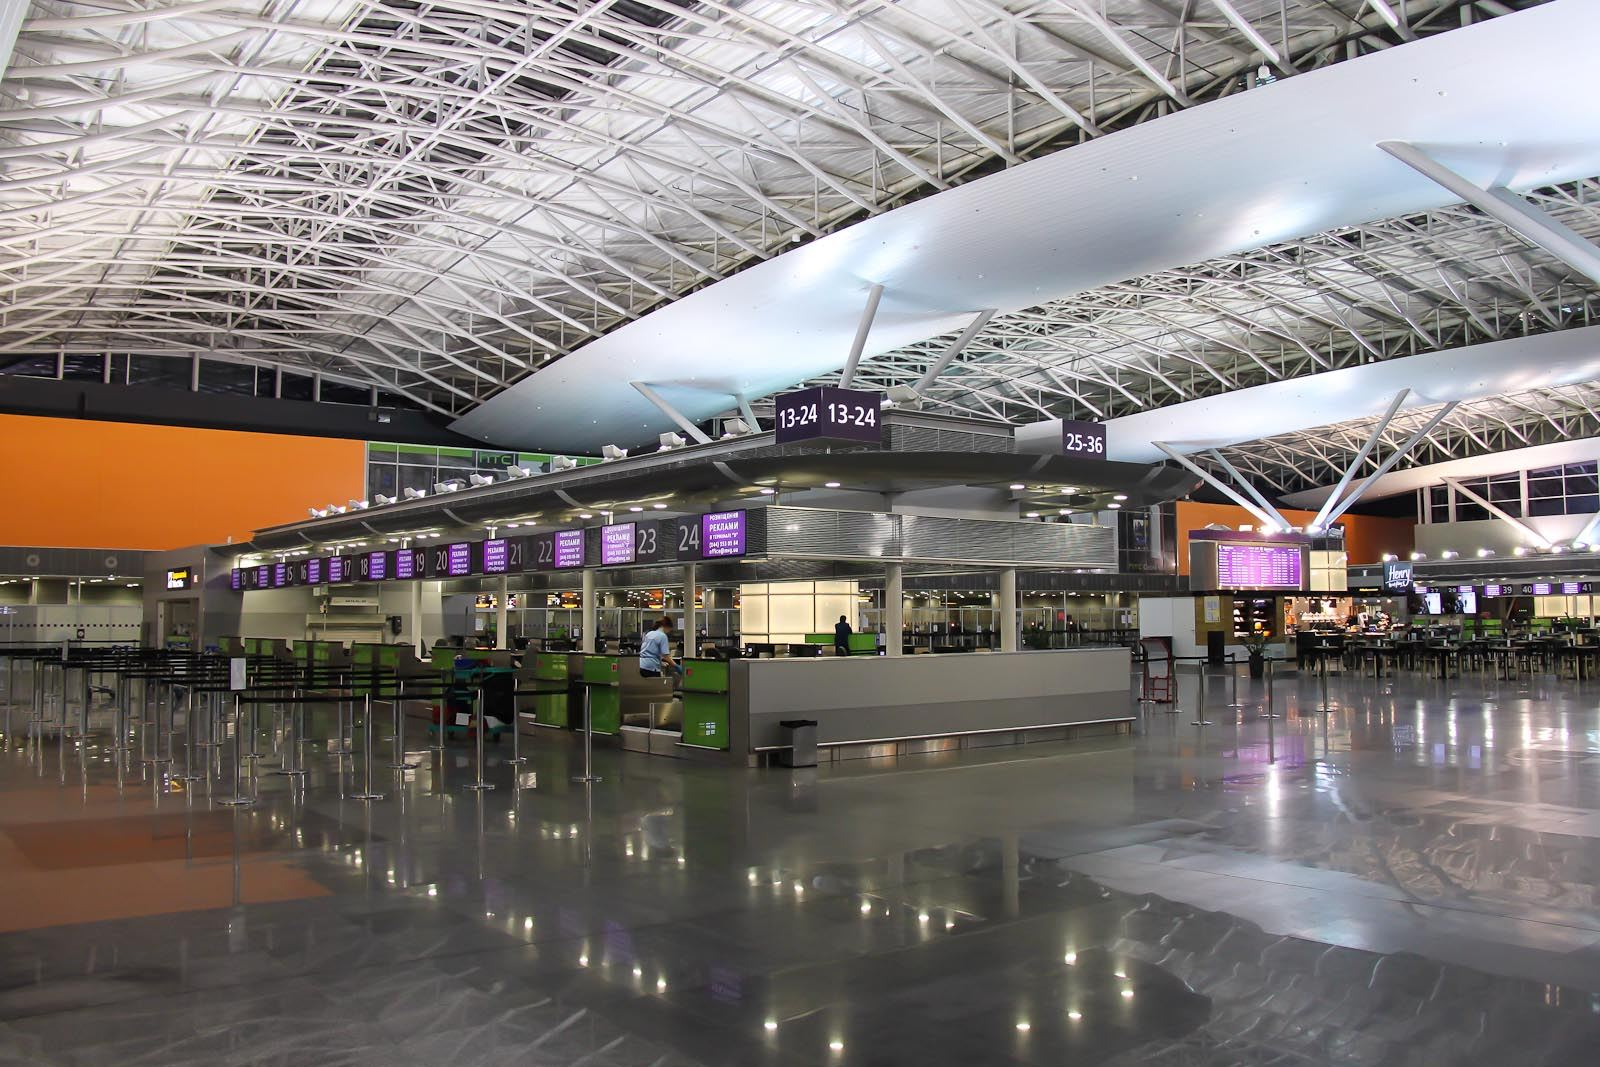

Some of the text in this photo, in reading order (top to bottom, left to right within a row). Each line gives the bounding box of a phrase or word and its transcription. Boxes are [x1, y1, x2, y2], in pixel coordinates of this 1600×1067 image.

[779, 403, 818, 429] 13-24
[828, 403, 876, 428] 13-24
[1066, 432, 1103, 454] 25-36
[709, 521, 739, 532] РЕКЛАМИ
[638, 528, 656, 554] 23
[679, 524, 700, 551] 24
[436, 550, 448, 570] 20
[510, 543, 522, 565] 21
[538, 540, 553, 563] 22
[300, 564, 307, 580] 16
[344, 559, 351, 577] 17
[360, 558, 368, 576] 18
[415, 552, 425, 573] 19
[287, 566, 293, 581] 15
[1389, 564, 1411, 586] Henry
[1502, 585, 1513, 594] 39
[1522, 585, 1533, 593] 40
[1582, 584, 1592, 592] 41
